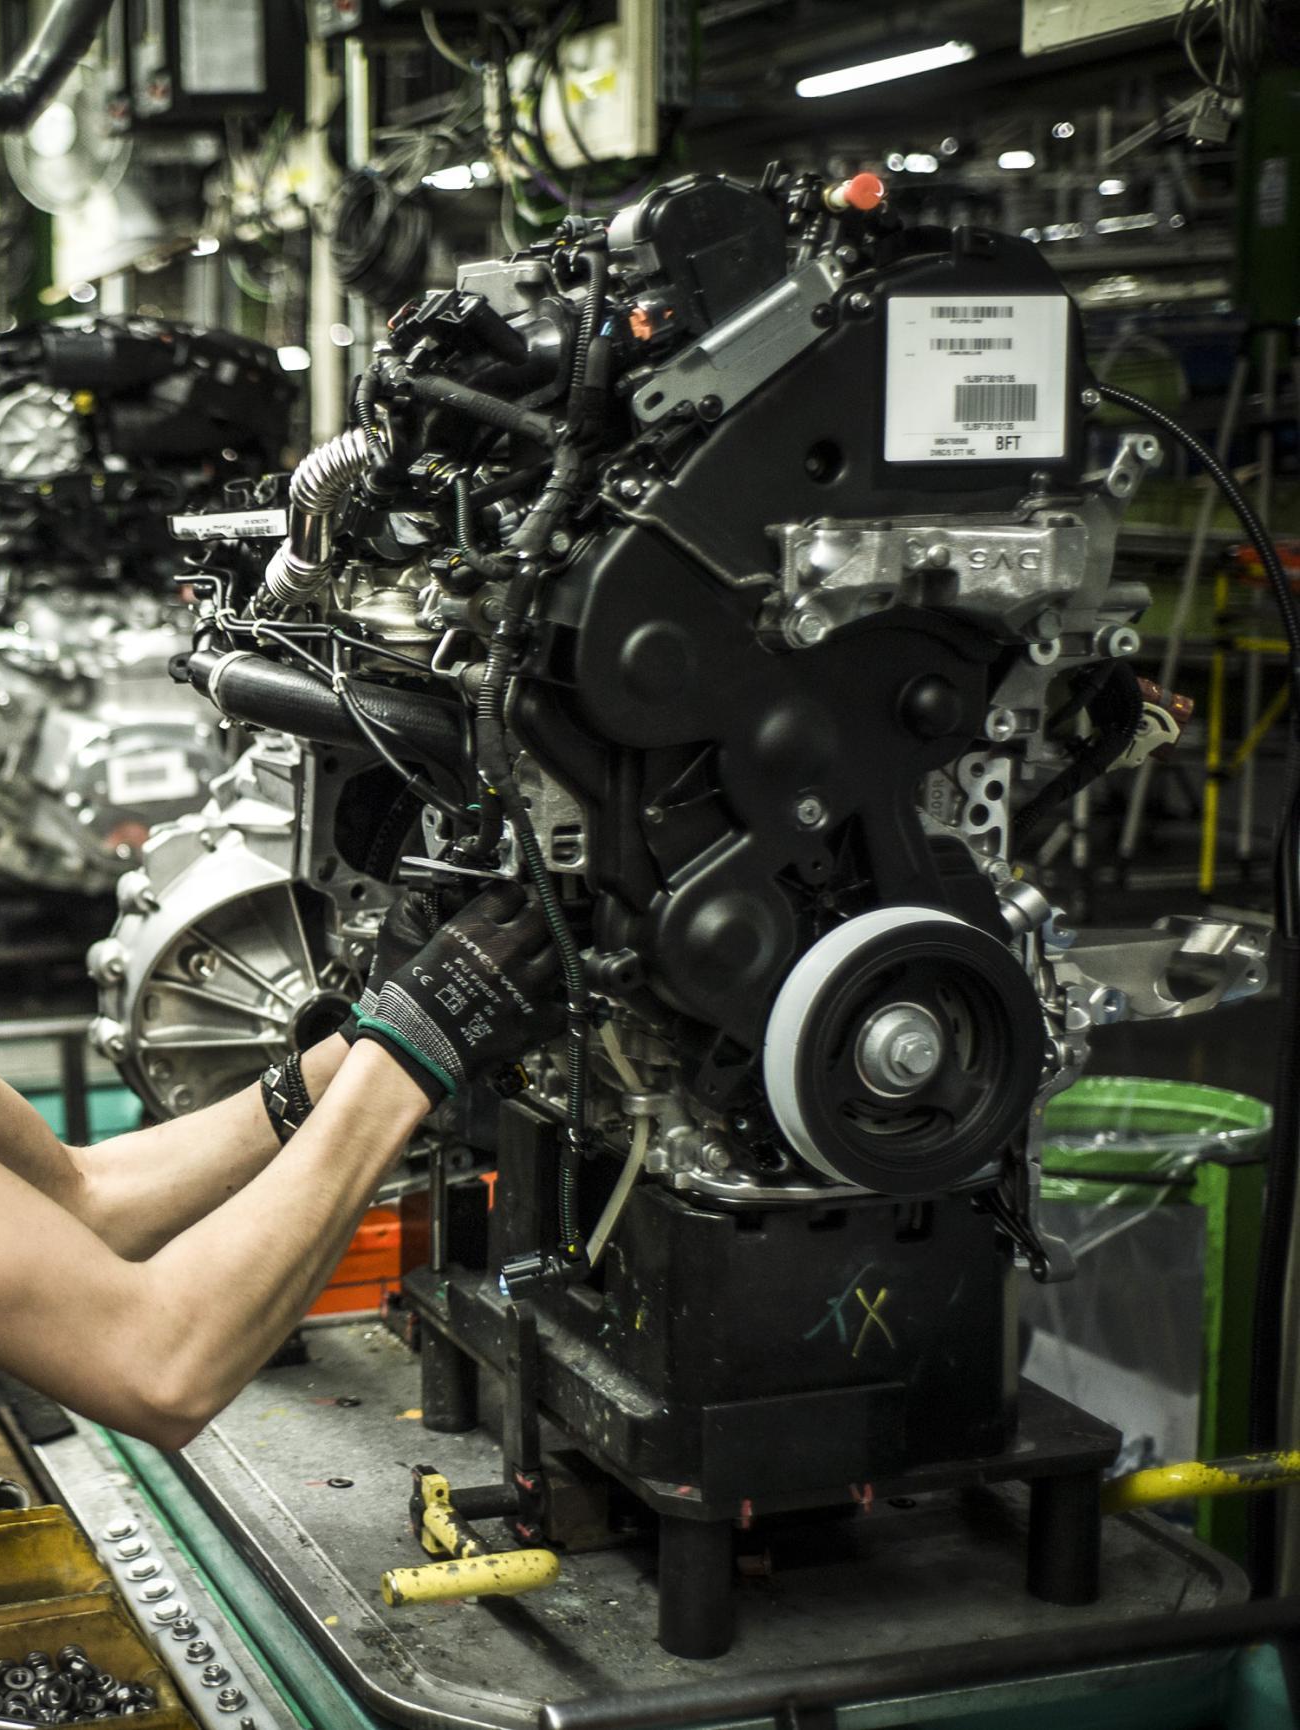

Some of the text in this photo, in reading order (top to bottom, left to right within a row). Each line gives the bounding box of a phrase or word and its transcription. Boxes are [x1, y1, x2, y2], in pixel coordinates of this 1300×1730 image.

[995, 435, 1022, 451] BFT
[454, 957, 472, 973] PU
[411, 966, 434, 987] CE
